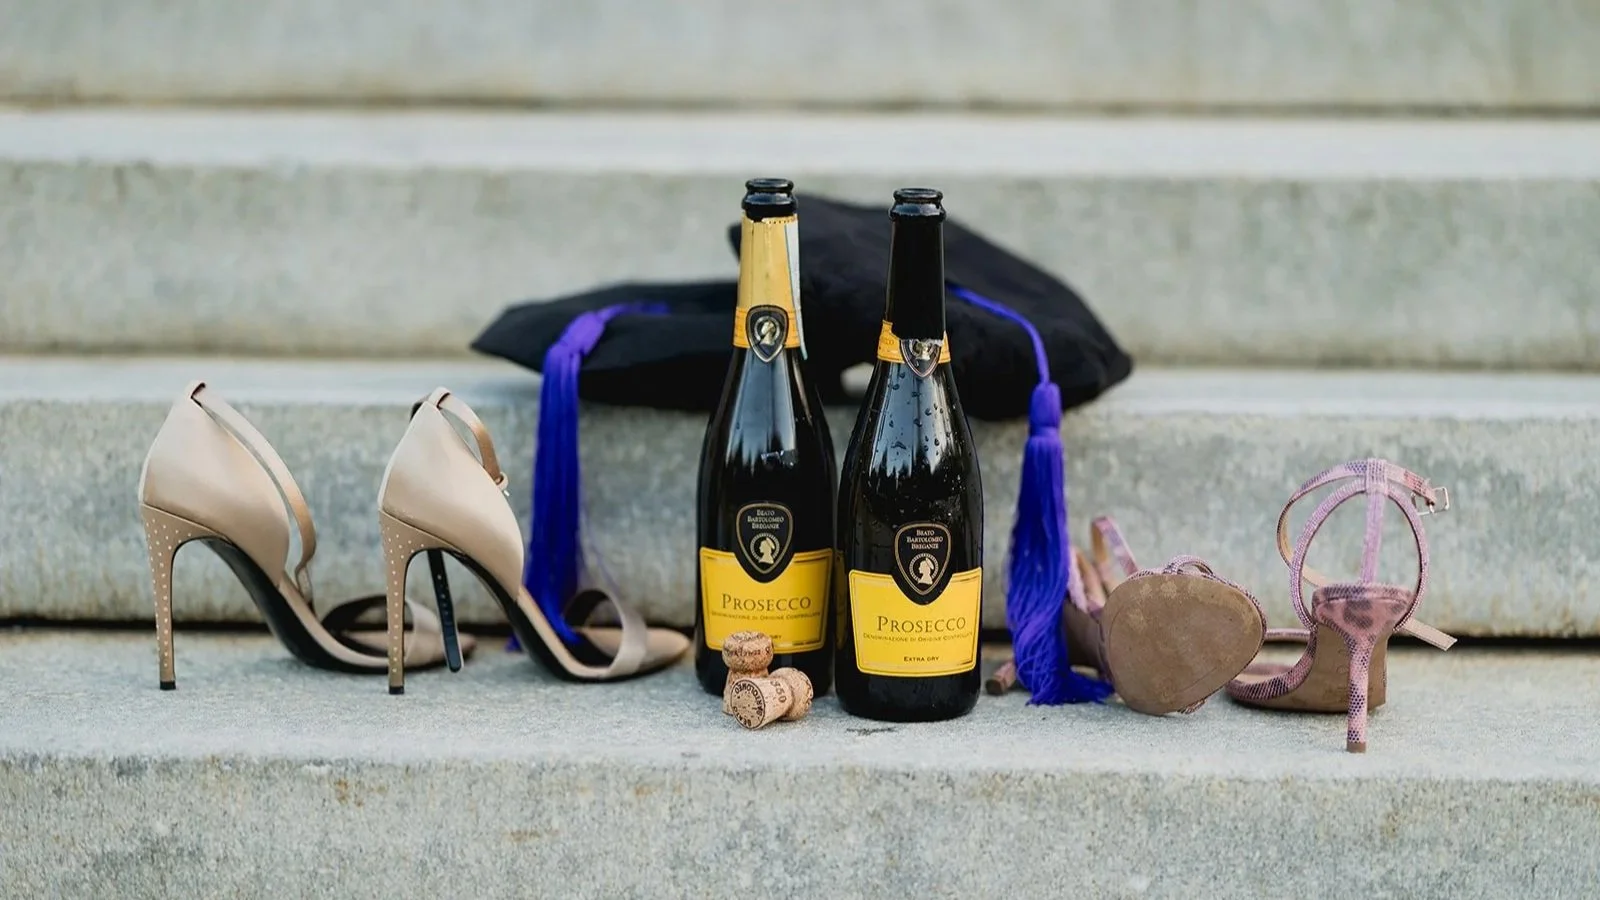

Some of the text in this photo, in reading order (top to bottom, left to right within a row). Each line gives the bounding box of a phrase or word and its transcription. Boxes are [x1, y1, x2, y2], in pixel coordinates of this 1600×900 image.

[747, 515, 785, 523] BARTOLOMEO
[751, 522, 780, 530] BREGANZE
[722, 593, 812, 612] PROSECCO
[877, 615, 966, 633] PROSECCO
